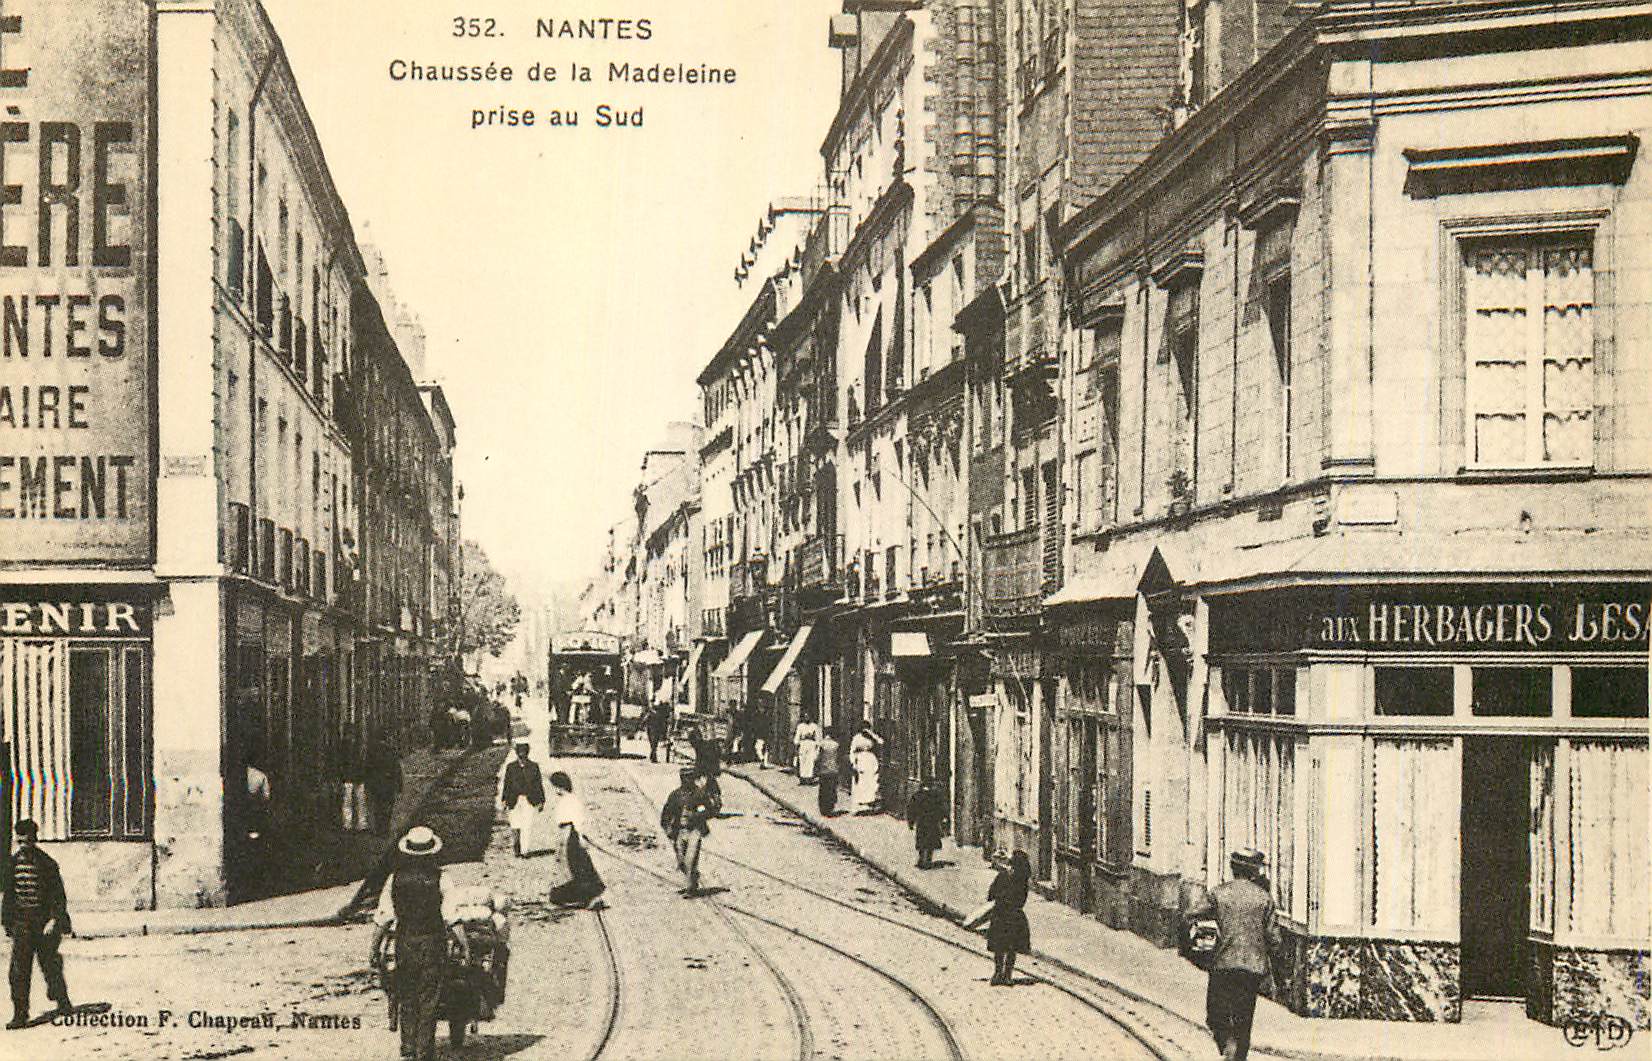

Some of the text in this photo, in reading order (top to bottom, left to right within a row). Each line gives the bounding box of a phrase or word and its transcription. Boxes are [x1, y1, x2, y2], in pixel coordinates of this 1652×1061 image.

[3, 294, 126, 358] NTES
[1321, 616, 1360, 642] aux
[1369, 602, 1552, 647] HERBAGERS
